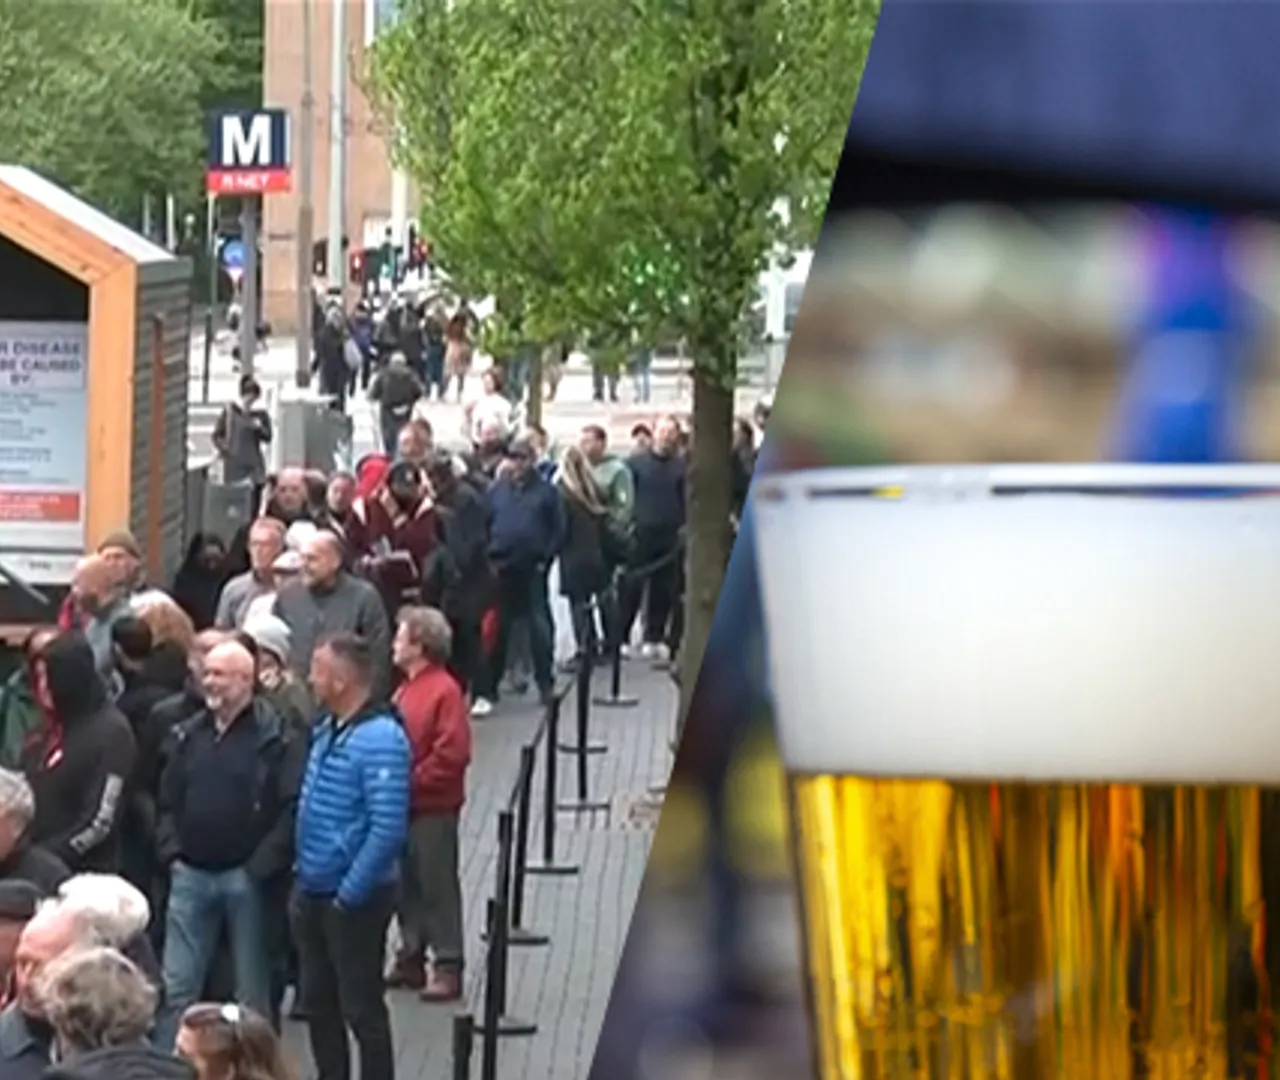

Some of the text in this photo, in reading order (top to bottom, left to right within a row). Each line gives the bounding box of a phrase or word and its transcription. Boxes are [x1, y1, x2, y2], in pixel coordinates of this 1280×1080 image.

[222, 114, 271, 166] M
[13, 342, 81, 355] DISEASE
[0, 359, 17, 371] BE
[21, 360, 81, 372] CAUSED
